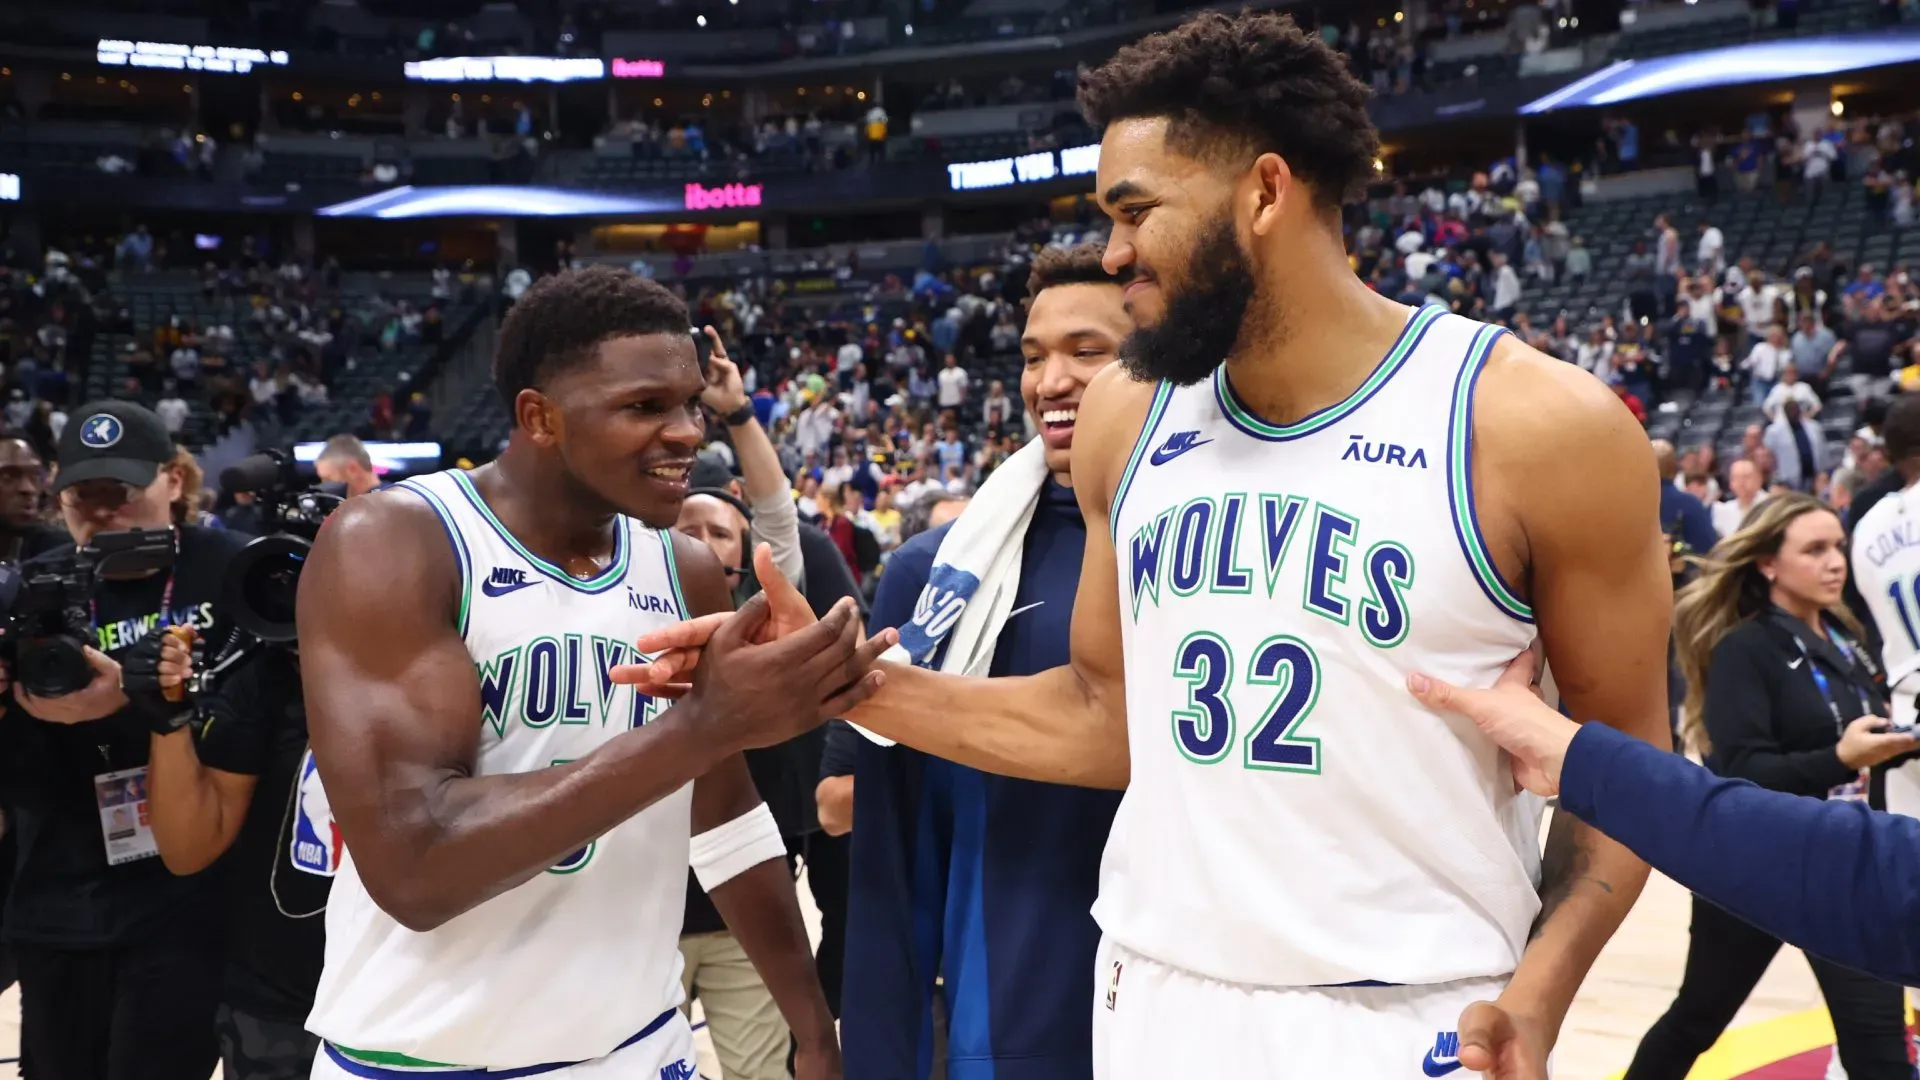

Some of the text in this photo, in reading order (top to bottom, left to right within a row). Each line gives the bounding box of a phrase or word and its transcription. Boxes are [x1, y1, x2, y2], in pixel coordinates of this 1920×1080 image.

[685, 181, 763, 210] ibotta
[1162, 430, 1201, 451] NIKE
[491, 566, 526, 585] NIKE
[1129, 492, 1415, 649] WOLVES
[1171, 630, 1322, 775] 32
[298, 841, 322, 866] NBA
